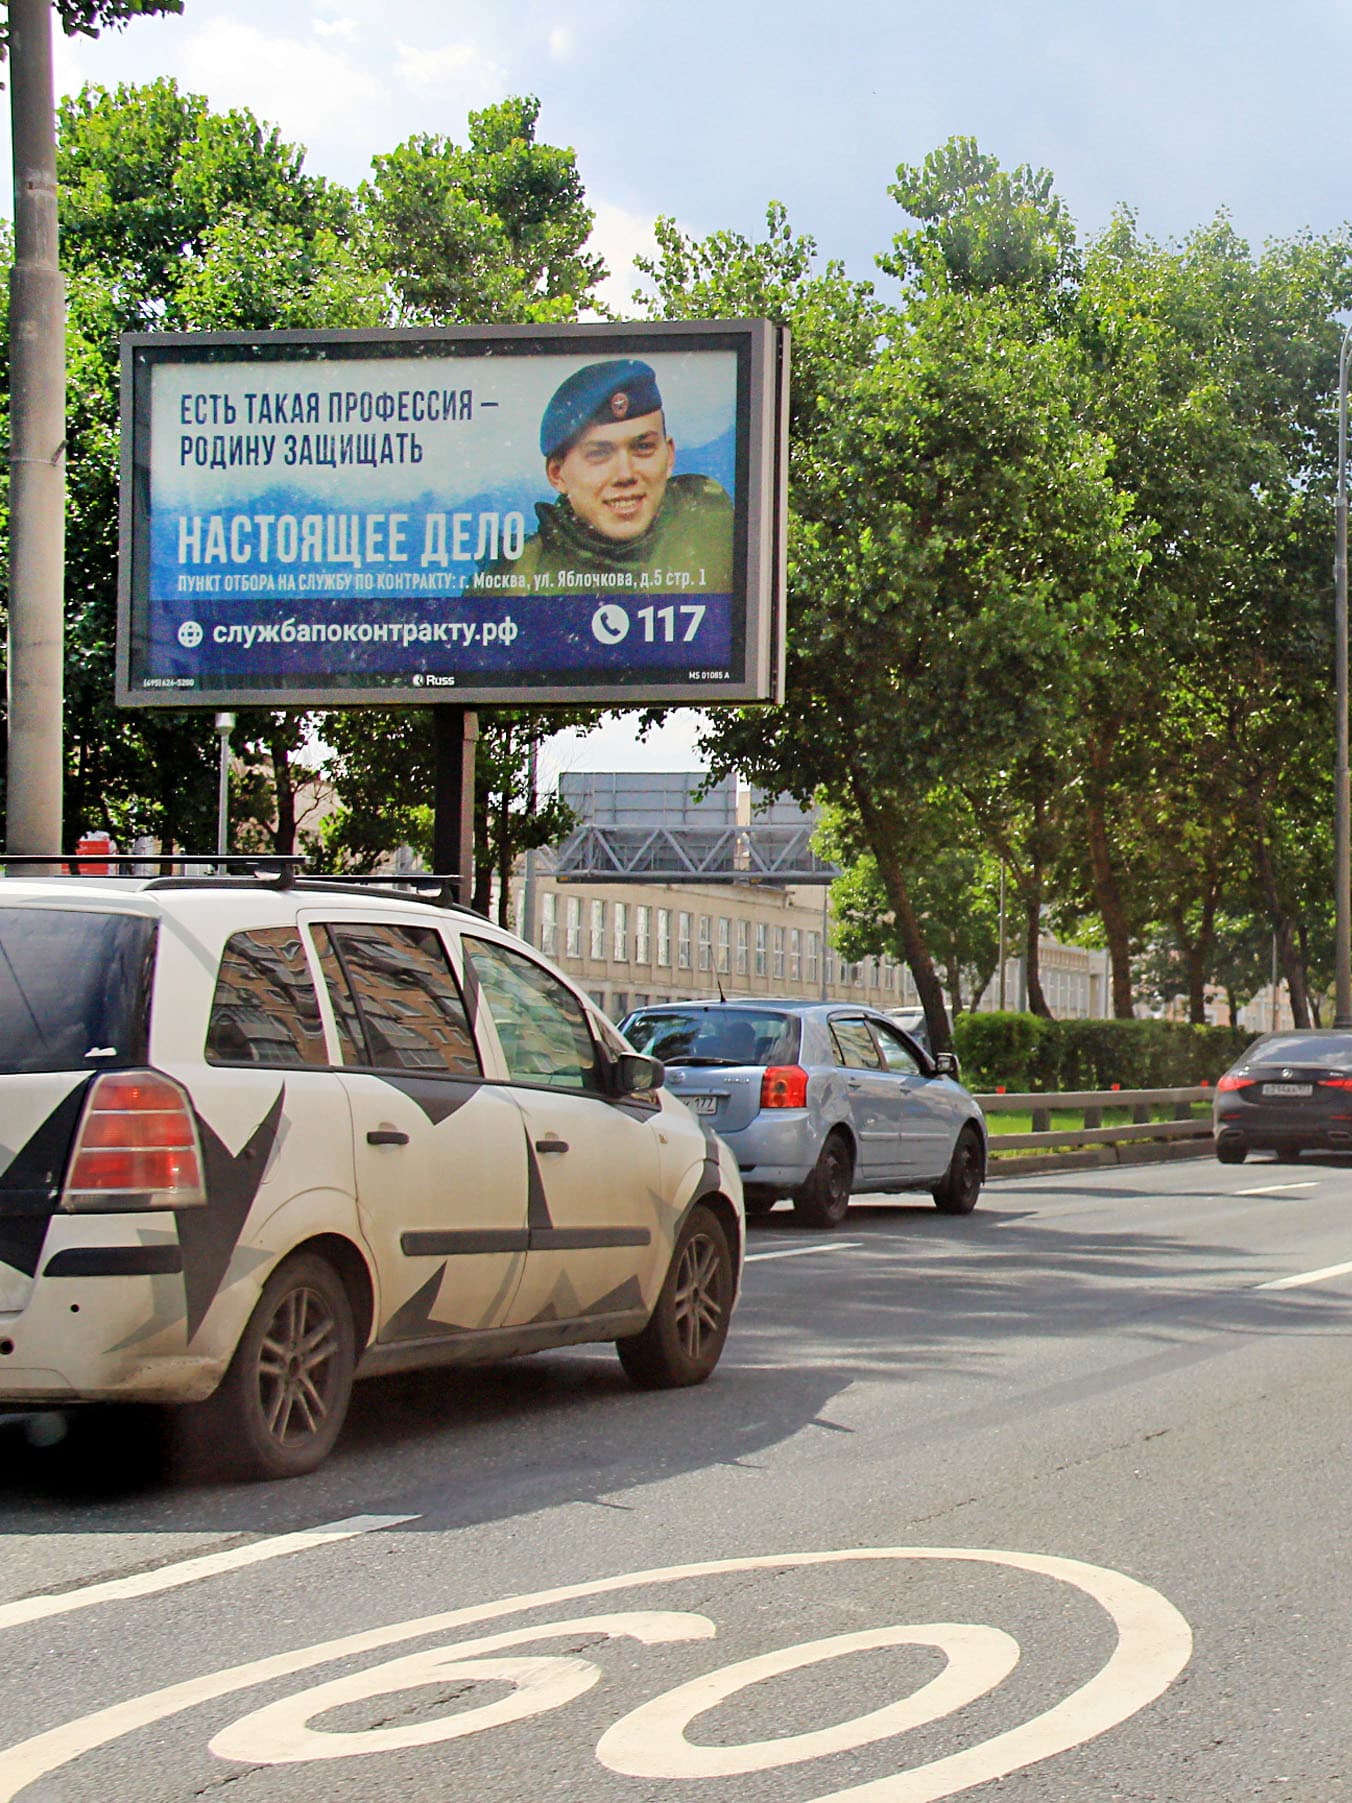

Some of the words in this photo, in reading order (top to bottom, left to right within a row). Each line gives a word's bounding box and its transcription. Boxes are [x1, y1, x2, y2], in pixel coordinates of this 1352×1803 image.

[181, 394, 236, 424] ЕСТЬ
[245, 392, 319, 424] ТАКАЯ
[329, 390, 473, 423] ПРОФЕССИЯ
[181, 435, 275, 469] РОДИНУ
[284, 433, 423, 468] ЗАЩИЩАТЬ
[178, 513, 408, 568] НАСТОЯЩЕЕ
[421, 511, 525, 567] ДЕЛО
[178, 575, 221, 592] ПУНКТ
[224, 574, 274, 591] ОТБОРА
[279, 574, 296, 591] НА
[299, 573, 350, 590] СЛУЖБУ
[355, 573, 373, 590] ПО
[377, 572, 457, 590] КОНТРАКТУ:
[459, 576, 468, 589] г.
[473, 573, 530, 590] Москва,
[534, 575, 554, 591] ул.
[558, 571, 637, 589] Яблочкова,
[640, 570, 662, 588] д.5
[666, 571, 694, 589] стр.
[700, 569, 707, 586] 1
[213, 616, 518, 648] службапоконтракту.рф
[637, 604, 707, 643] 117
[426, 674, 455, 686] Russ
[208, 1610, 1021, 1778] 60
